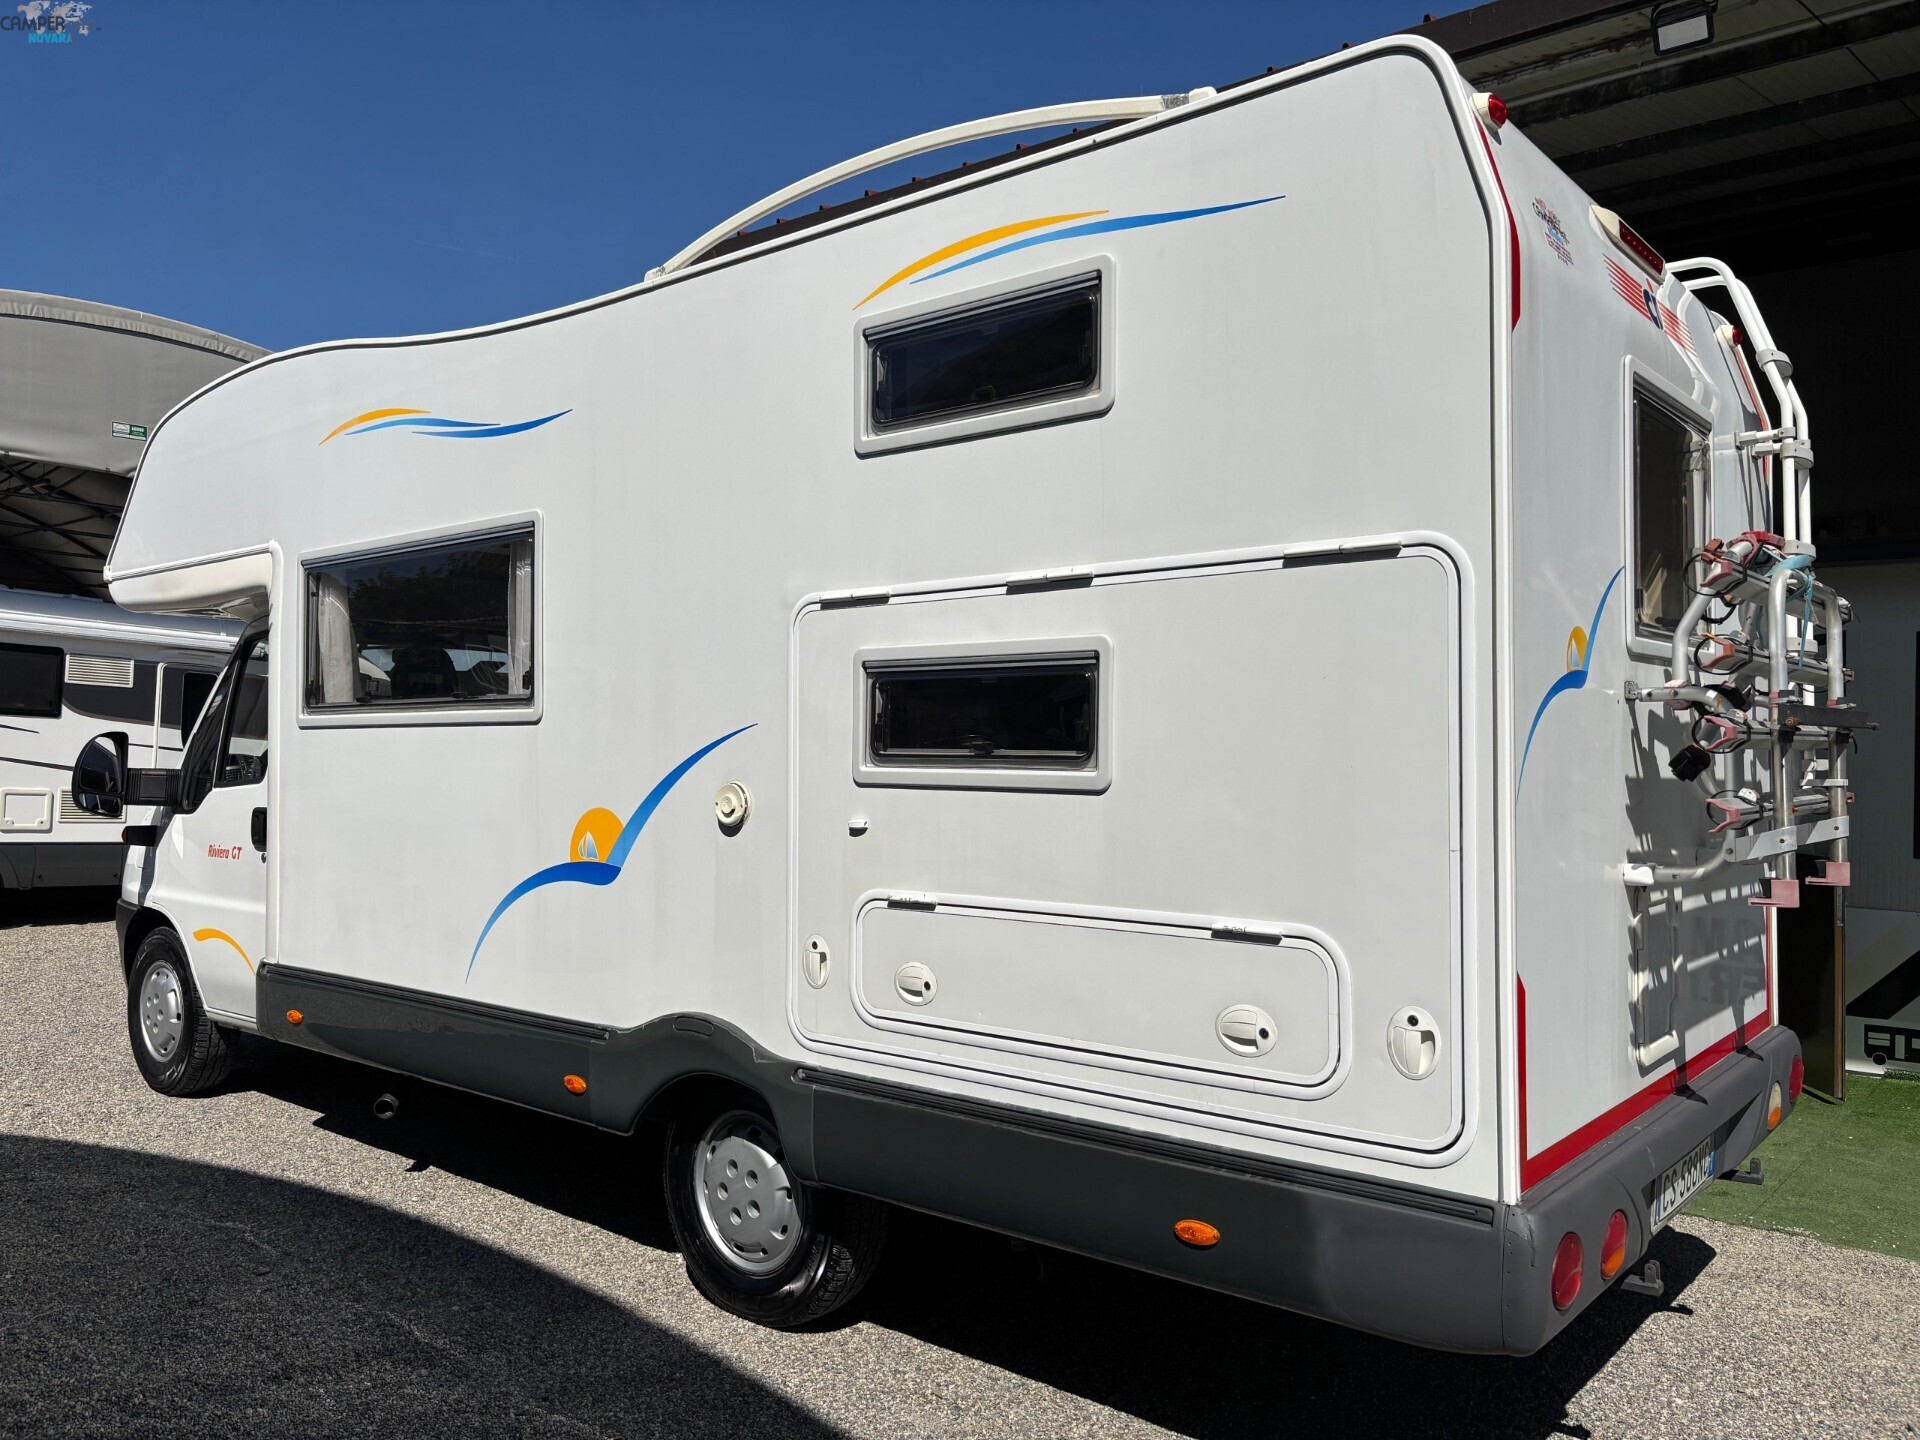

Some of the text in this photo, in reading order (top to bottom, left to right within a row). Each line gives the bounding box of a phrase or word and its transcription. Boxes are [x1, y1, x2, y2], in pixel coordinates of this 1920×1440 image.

[208, 844, 243, 860] Riviera GT
[1662, 1168, 1678, 1213] CS
